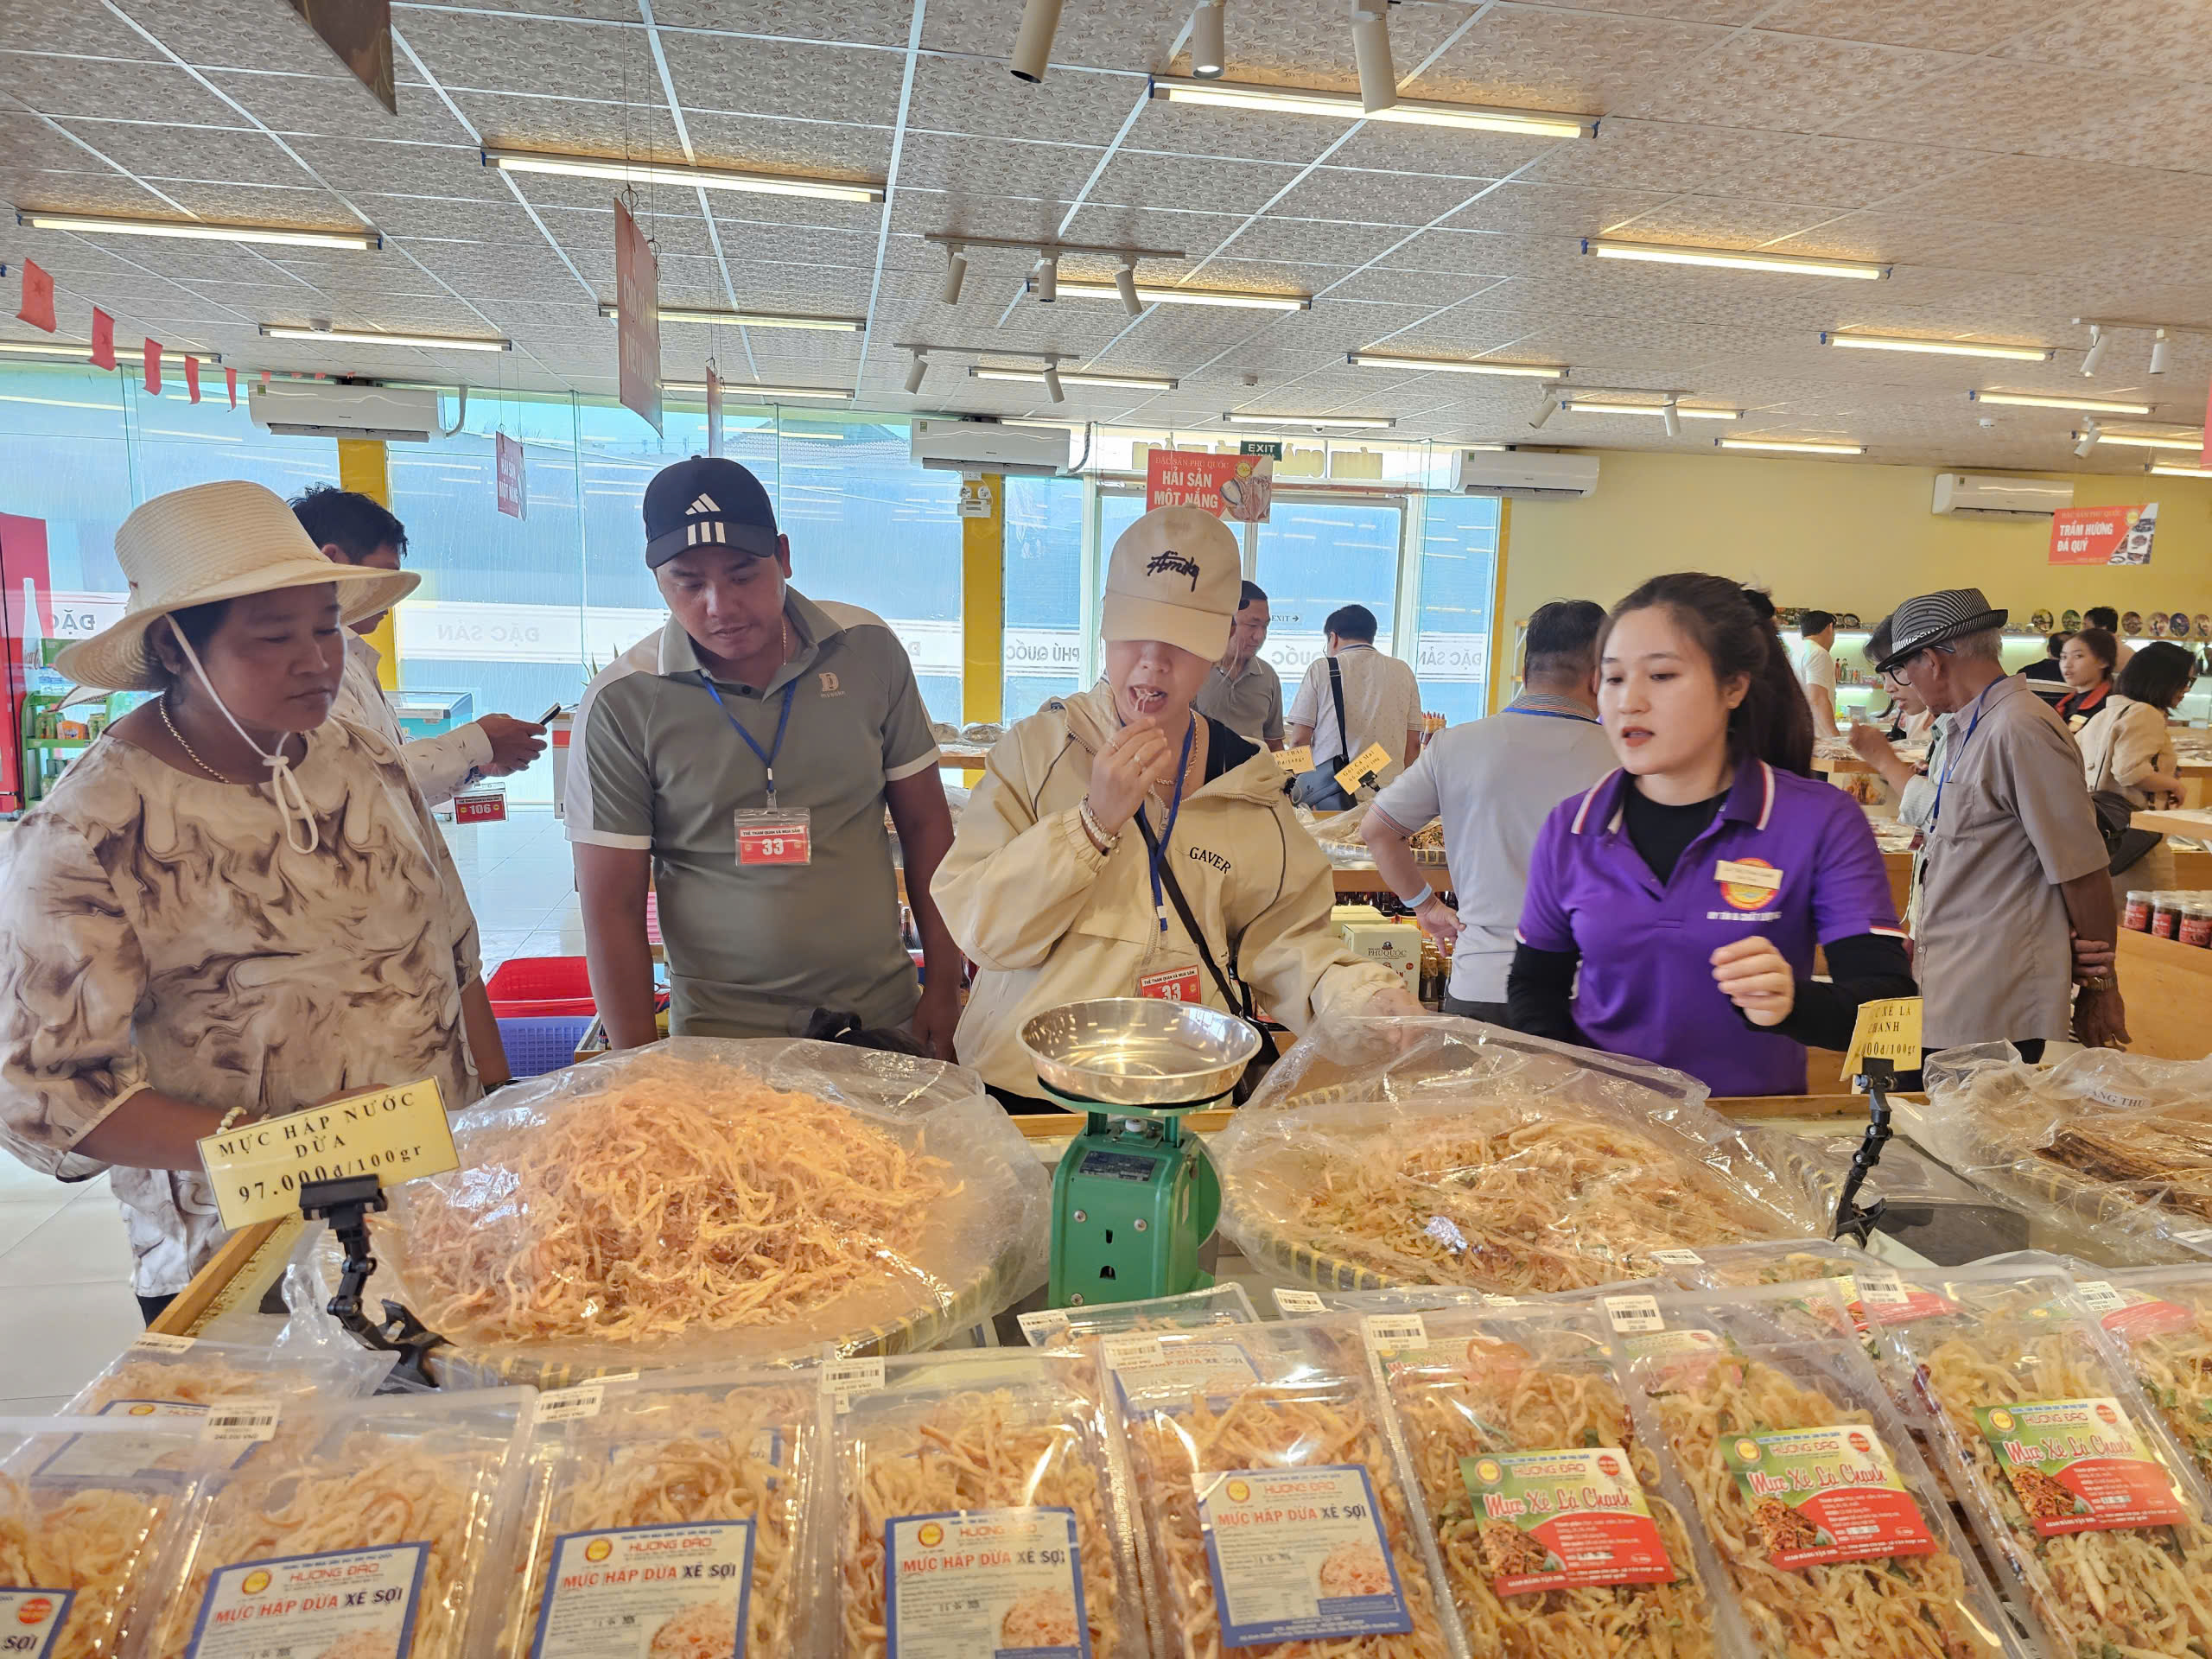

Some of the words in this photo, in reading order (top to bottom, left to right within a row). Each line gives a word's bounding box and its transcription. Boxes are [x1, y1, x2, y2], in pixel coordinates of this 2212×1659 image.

[1248, 443, 1275, 453] EXIT
[1162, 467, 1183, 486] HẢI
[1187, 468, 1211, 487] SẢN
[1185, 487, 1217, 508] NẮNG
[2085, 522, 2113, 535] HƯƠNG
[469, 804, 492, 815] 106
[761, 838, 784, 855] 33
[1190, 847, 1230, 874] GAVER
[219, 1133, 270, 1157] MỰC
[283, 1116, 330, 1141] HẤP
[343, 1092, 415, 1123] NƯỚC
[295, 1134, 346, 1159] DỪA
[2041, 1438, 2068, 1460] Xé
[2068, 1435, 2090, 1457] Lá
[2090, 1434, 2135, 1456] Chanh
[1786, 1467, 1813, 1490] Xé
[1815, 1465, 1838, 1487] Lá
[1840, 1463, 1887, 1484] Chanh
[1525, 1490, 1552, 1512] Xé
[1556, 1487, 1580, 1510] Lá
[1582, 1486, 1632, 1509] Chanh
[1217, 1512, 1250, 1529] MỰC
[1287, 1506, 1318, 1521] DỪA
[1321, 1503, 1339, 1518] XÉ
[1343, 1503, 1367, 1520] SỢI
[903, 1555, 939, 1573] MỰC
[981, 1548, 1012, 1566] DỪA
[1017, 1548, 1035, 1563] XÉ
[564, 1573, 599, 1589] MỰC
[644, 1564, 677, 1581] DỪA
[683, 1562, 702, 1578] XÉ
[709, 1564, 736, 1580] SỢI
[216, 1605, 254, 1624] MỰC
[303, 1592, 339, 1611] DỪA
[345, 1588, 366, 1605] XÉ
[372, 1586, 403, 1605] SỢI
[4, 1635, 38, 1652] SỢI
